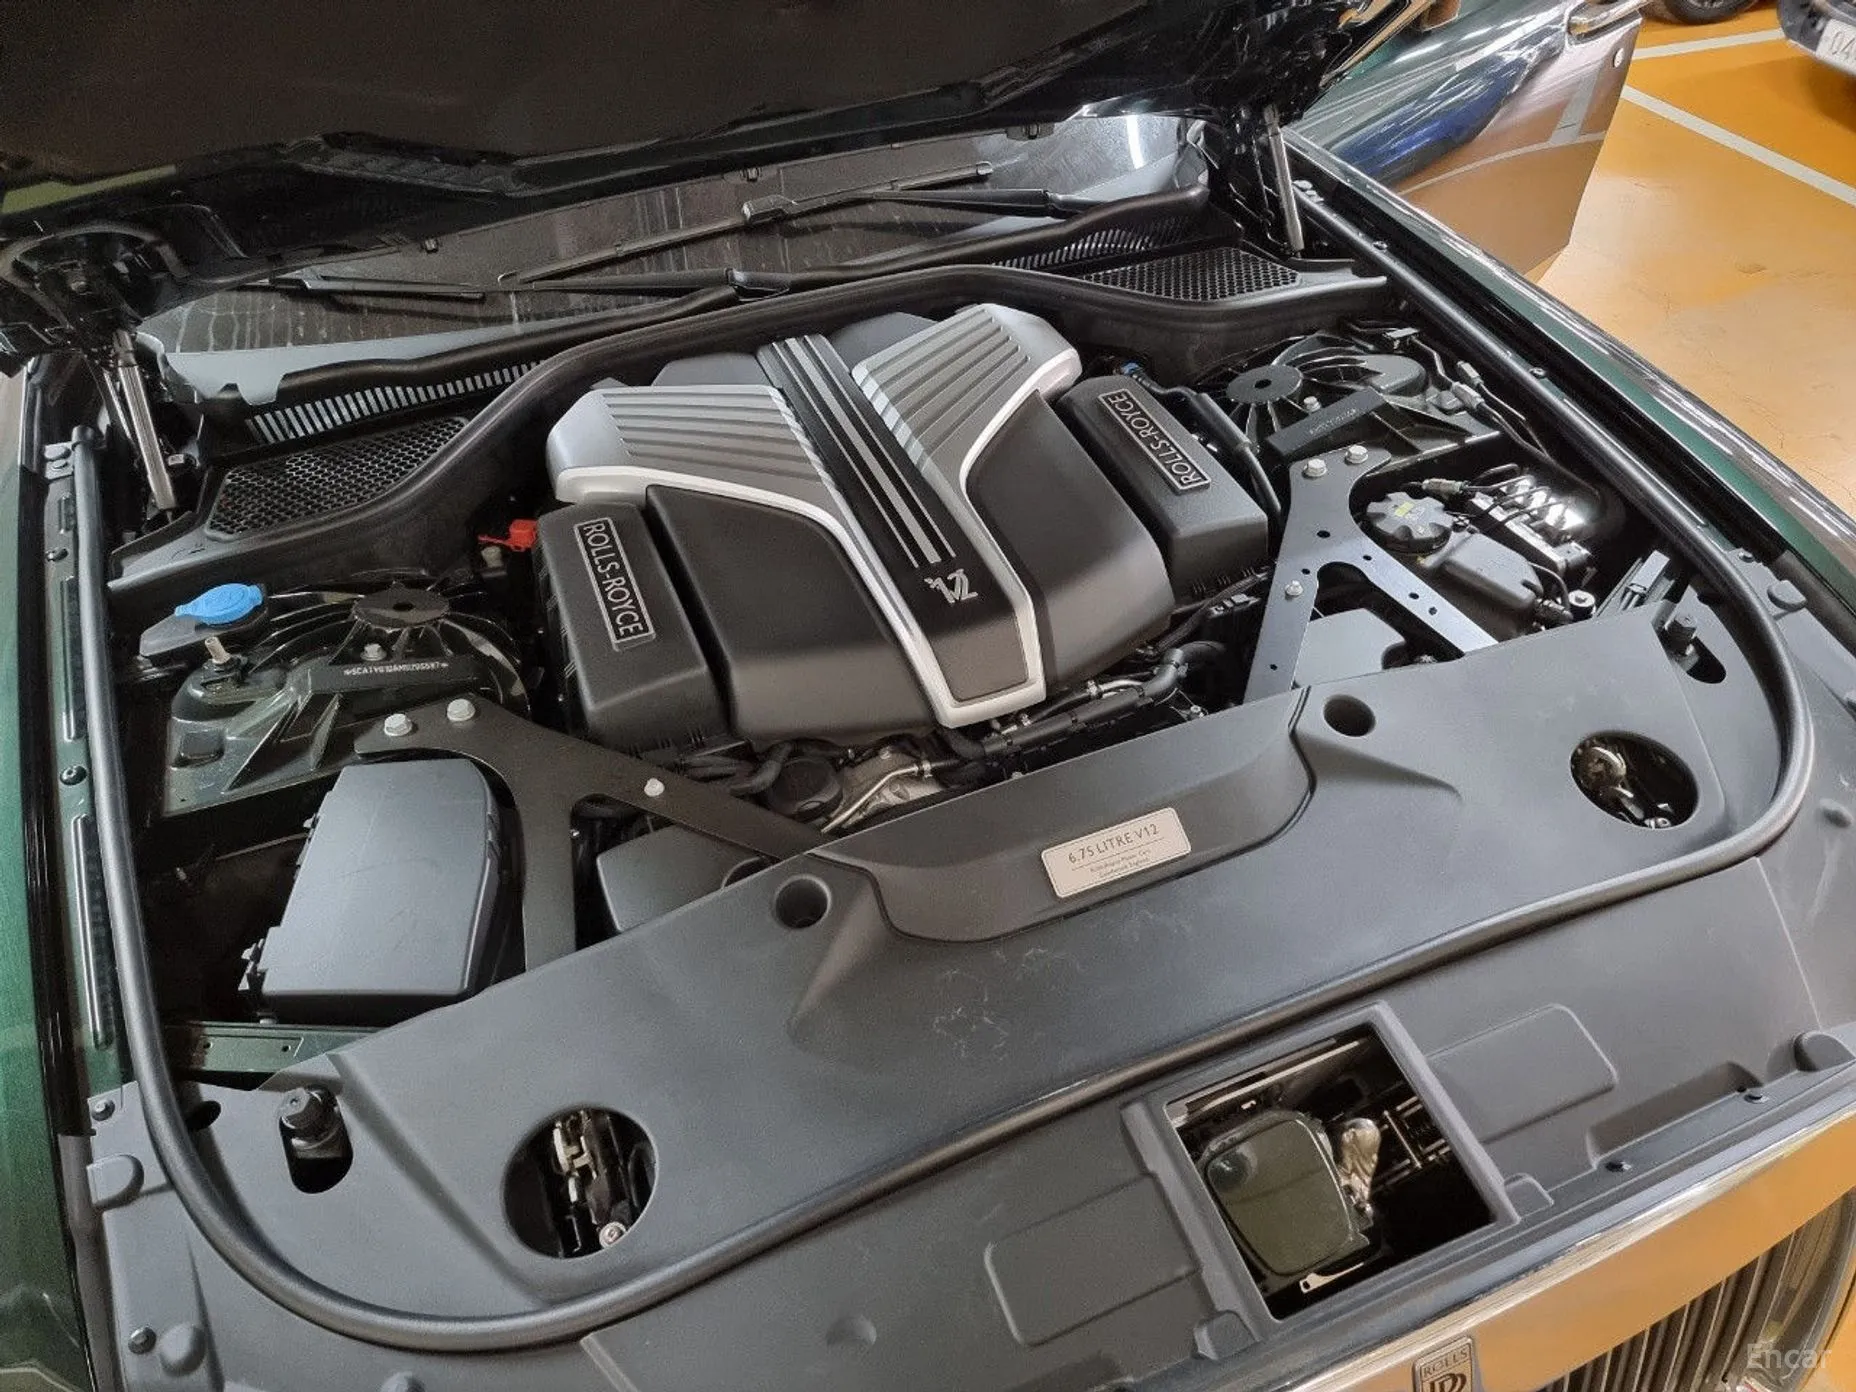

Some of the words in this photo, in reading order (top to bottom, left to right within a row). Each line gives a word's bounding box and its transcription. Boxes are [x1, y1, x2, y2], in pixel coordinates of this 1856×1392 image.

[1107, 393, 1202, 484] ROLLS-ROYCE
[583, 522, 644, 637] ROLLS-ROYCE
[1068, 846, 1095, 864] 6.75
[1095, 832, 1134, 854] LITRE
[1134, 823, 1160, 839] V12
[1423, 1347, 1468, 1378] ROLLS
